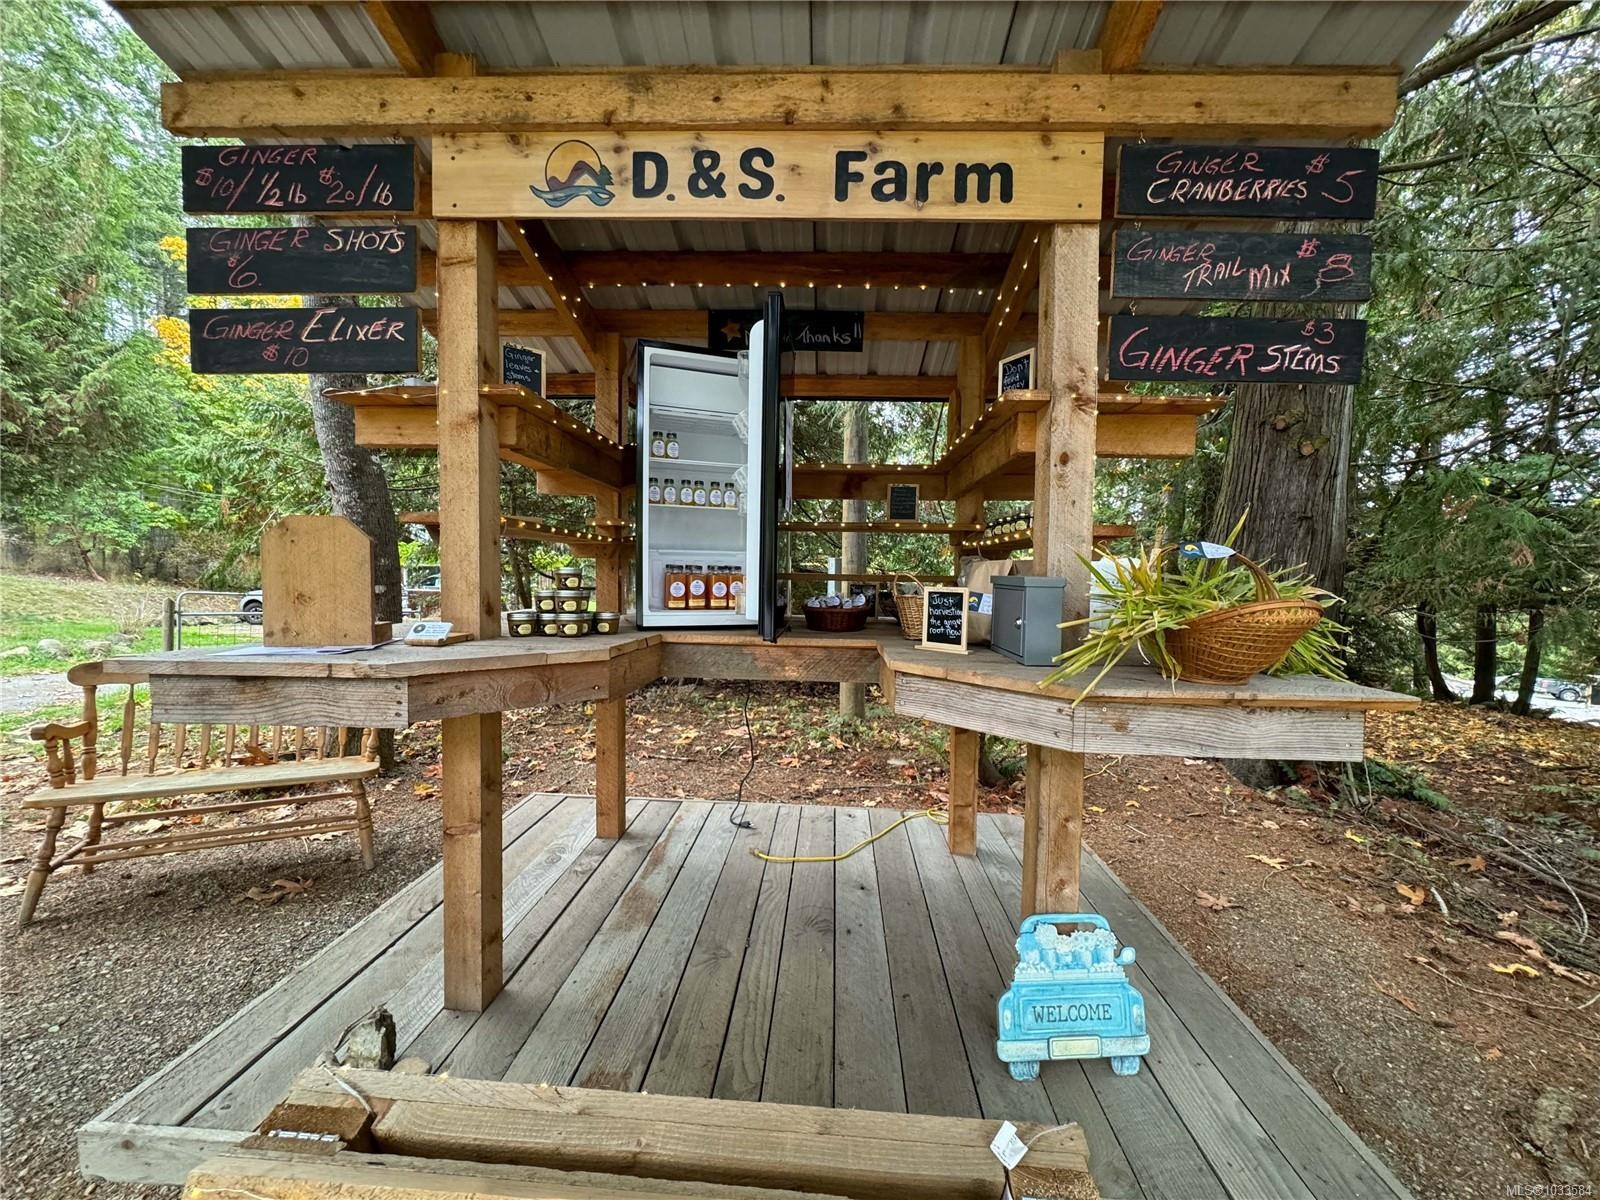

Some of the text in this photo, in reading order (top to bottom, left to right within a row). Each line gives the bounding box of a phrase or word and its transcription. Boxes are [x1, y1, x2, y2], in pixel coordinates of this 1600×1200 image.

[218, 148, 318, 166] GINGER
[1155, 150, 1265, 175] GINGER
[833, 149, 1015, 204] Farm
[1146, 177, 1309, 204] CRANBERRIES
[209, 228, 406, 254] GINGER SHOTS
[1126, 237, 1217, 264] GINGER
[1183, 257, 1246, 294] TRAIL
[202, 307, 406, 344] GINGER ELIXER
[1118, 326, 1255, 377] GINGER
[929, 606, 963, 616] harvestin
[931, 594, 954, 606] Just
[929, 626, 961, 636] root now
[930, 617, 941, 627] the
[1031, 1003, 1113, 1024] WELCOME
